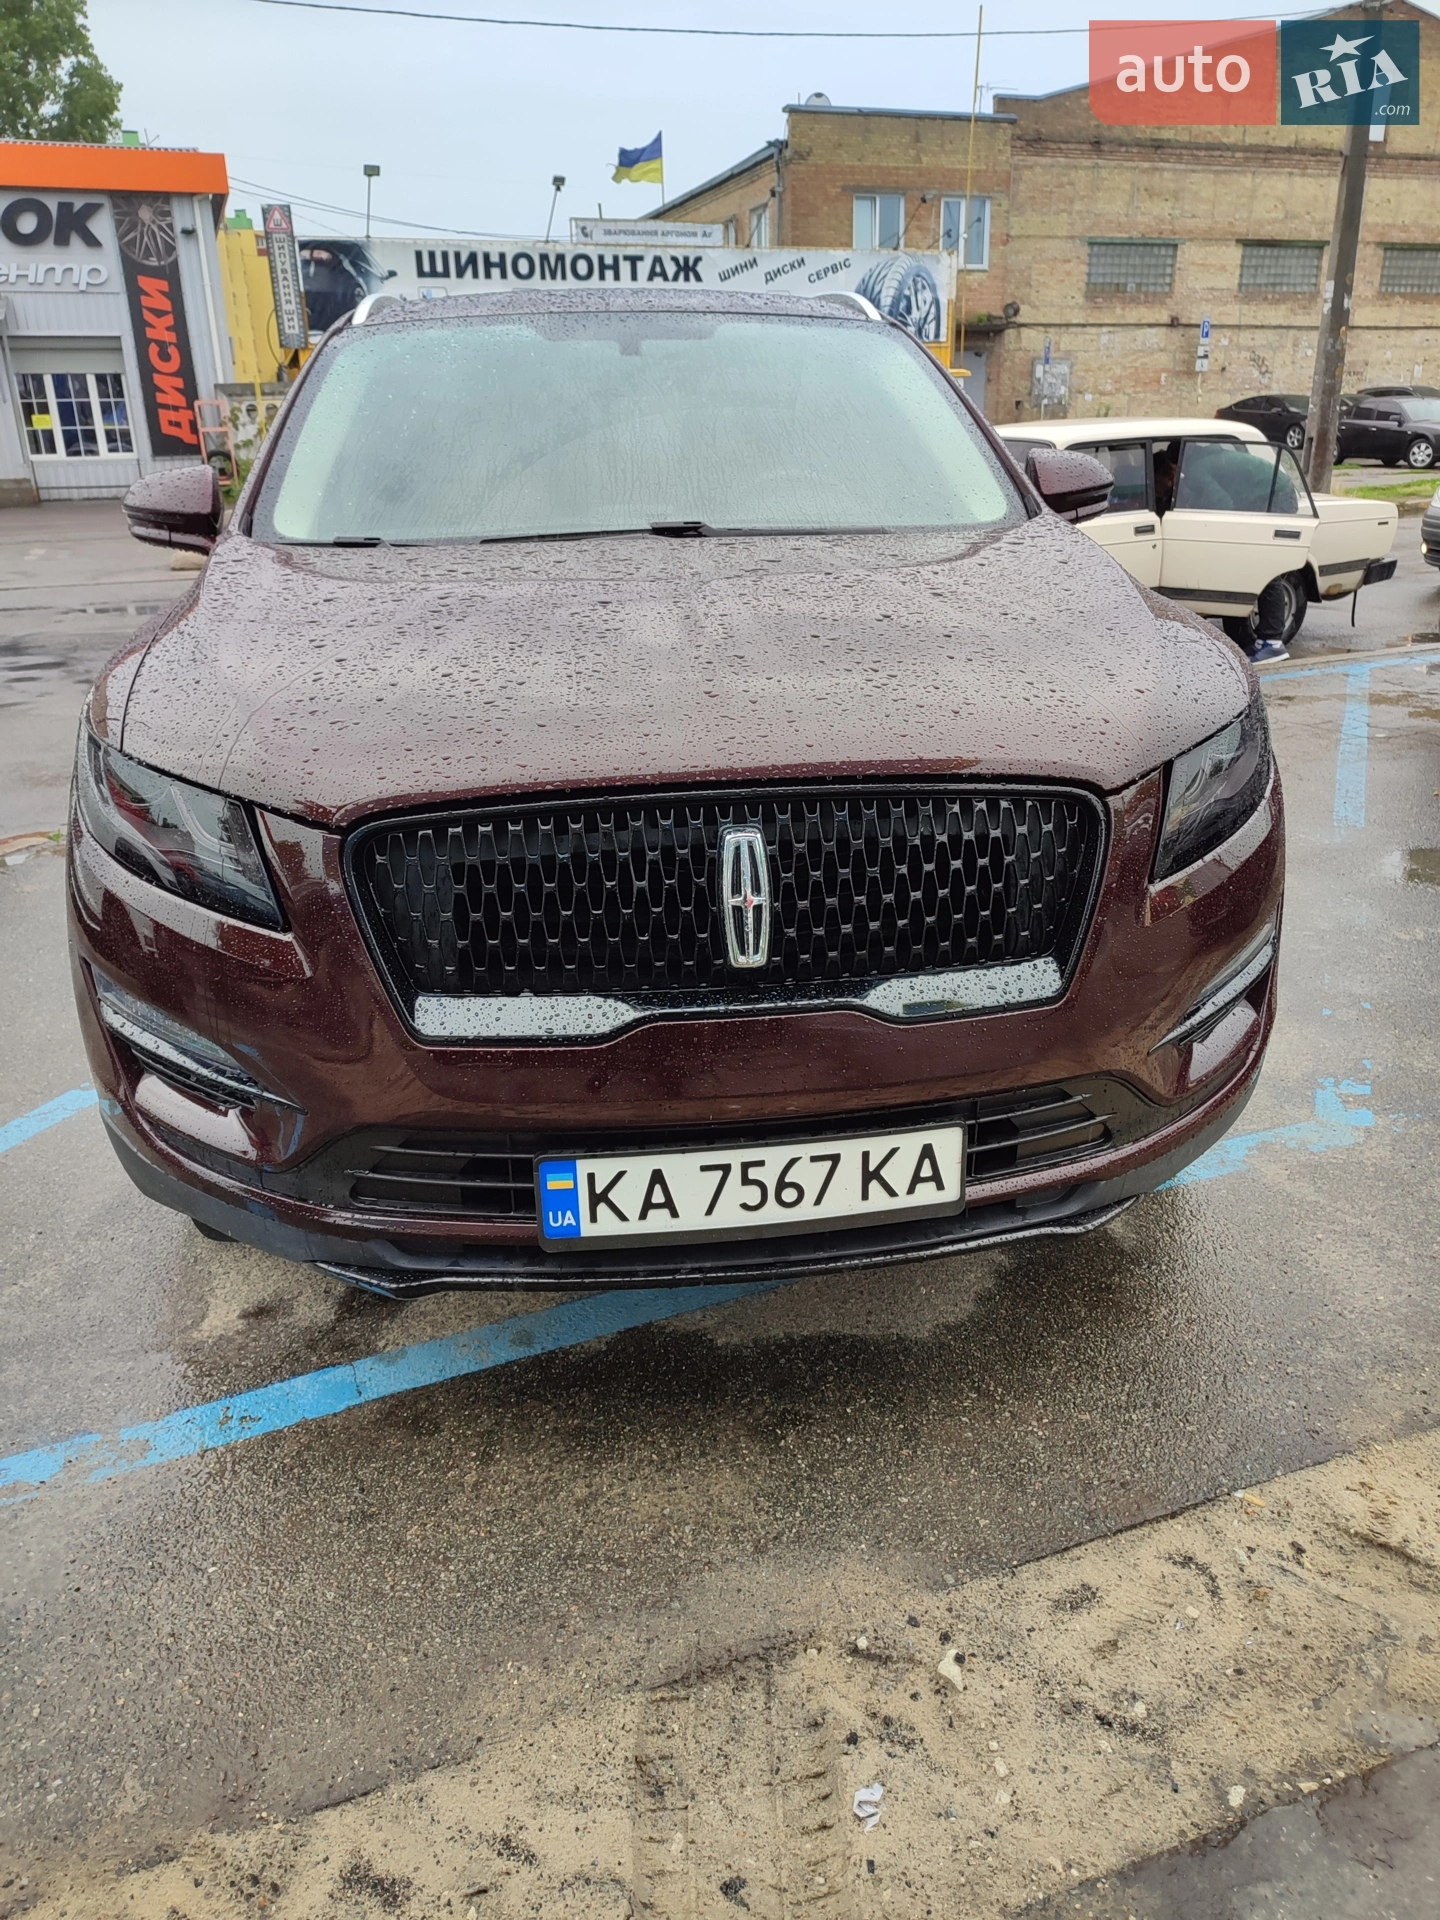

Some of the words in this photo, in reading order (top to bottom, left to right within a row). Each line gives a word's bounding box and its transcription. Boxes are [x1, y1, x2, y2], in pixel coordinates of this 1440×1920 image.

[602, 228, 659, 237] ЗВАРЮВАННЯ
[660, 229, 698, 238] АРГОНОМ
[415, 250, 703, 283] ШИНОМОНТАЖ
[717, 257, 759, 283] ШИНИ
[763, 257, 806, 285] ДИСКИ
[807, 258, 852, 284] СЕРВІС
[275, 236, 292, 305] ШИПУВАННЯ
[284, 309, 296, 331] ШИН
[137, 275, 198, 444] ДИСКИ
[586, 1168, 680, 1224] KA
[699, 1153, 842, 1216] 7567
[860, 1142, 946, 1202] KA
[548, 1211, 577, 1228] UA
